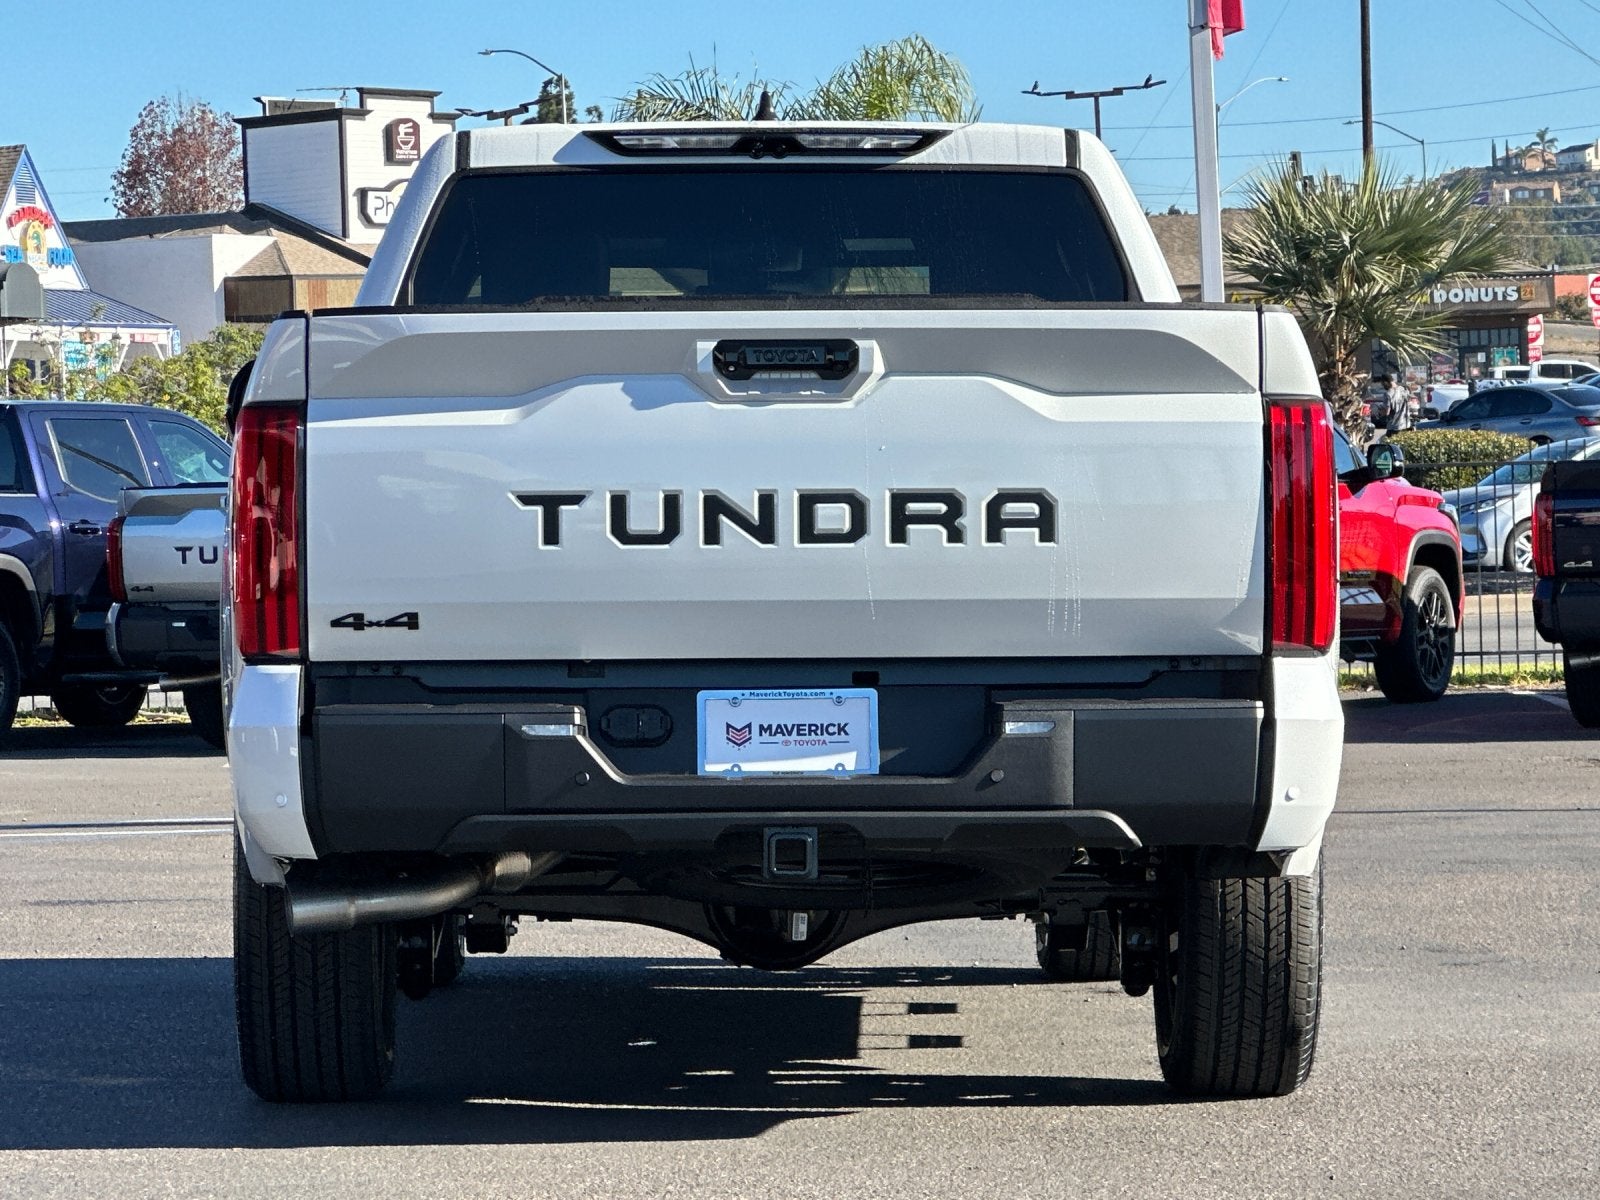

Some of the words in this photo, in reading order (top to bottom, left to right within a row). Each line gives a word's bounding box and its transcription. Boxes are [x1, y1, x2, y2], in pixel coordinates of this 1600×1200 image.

[1433, 286, 1519, 303] DONUTS
[753, 349, 820, 362] TOYOTA
[508, 490, 1059, 548] TUNDRA
[330, 612, 419, 630] 4x4
[758, 722, 850, 737] MAVERICK
[793, 739, 828, 747] TOYOTA
